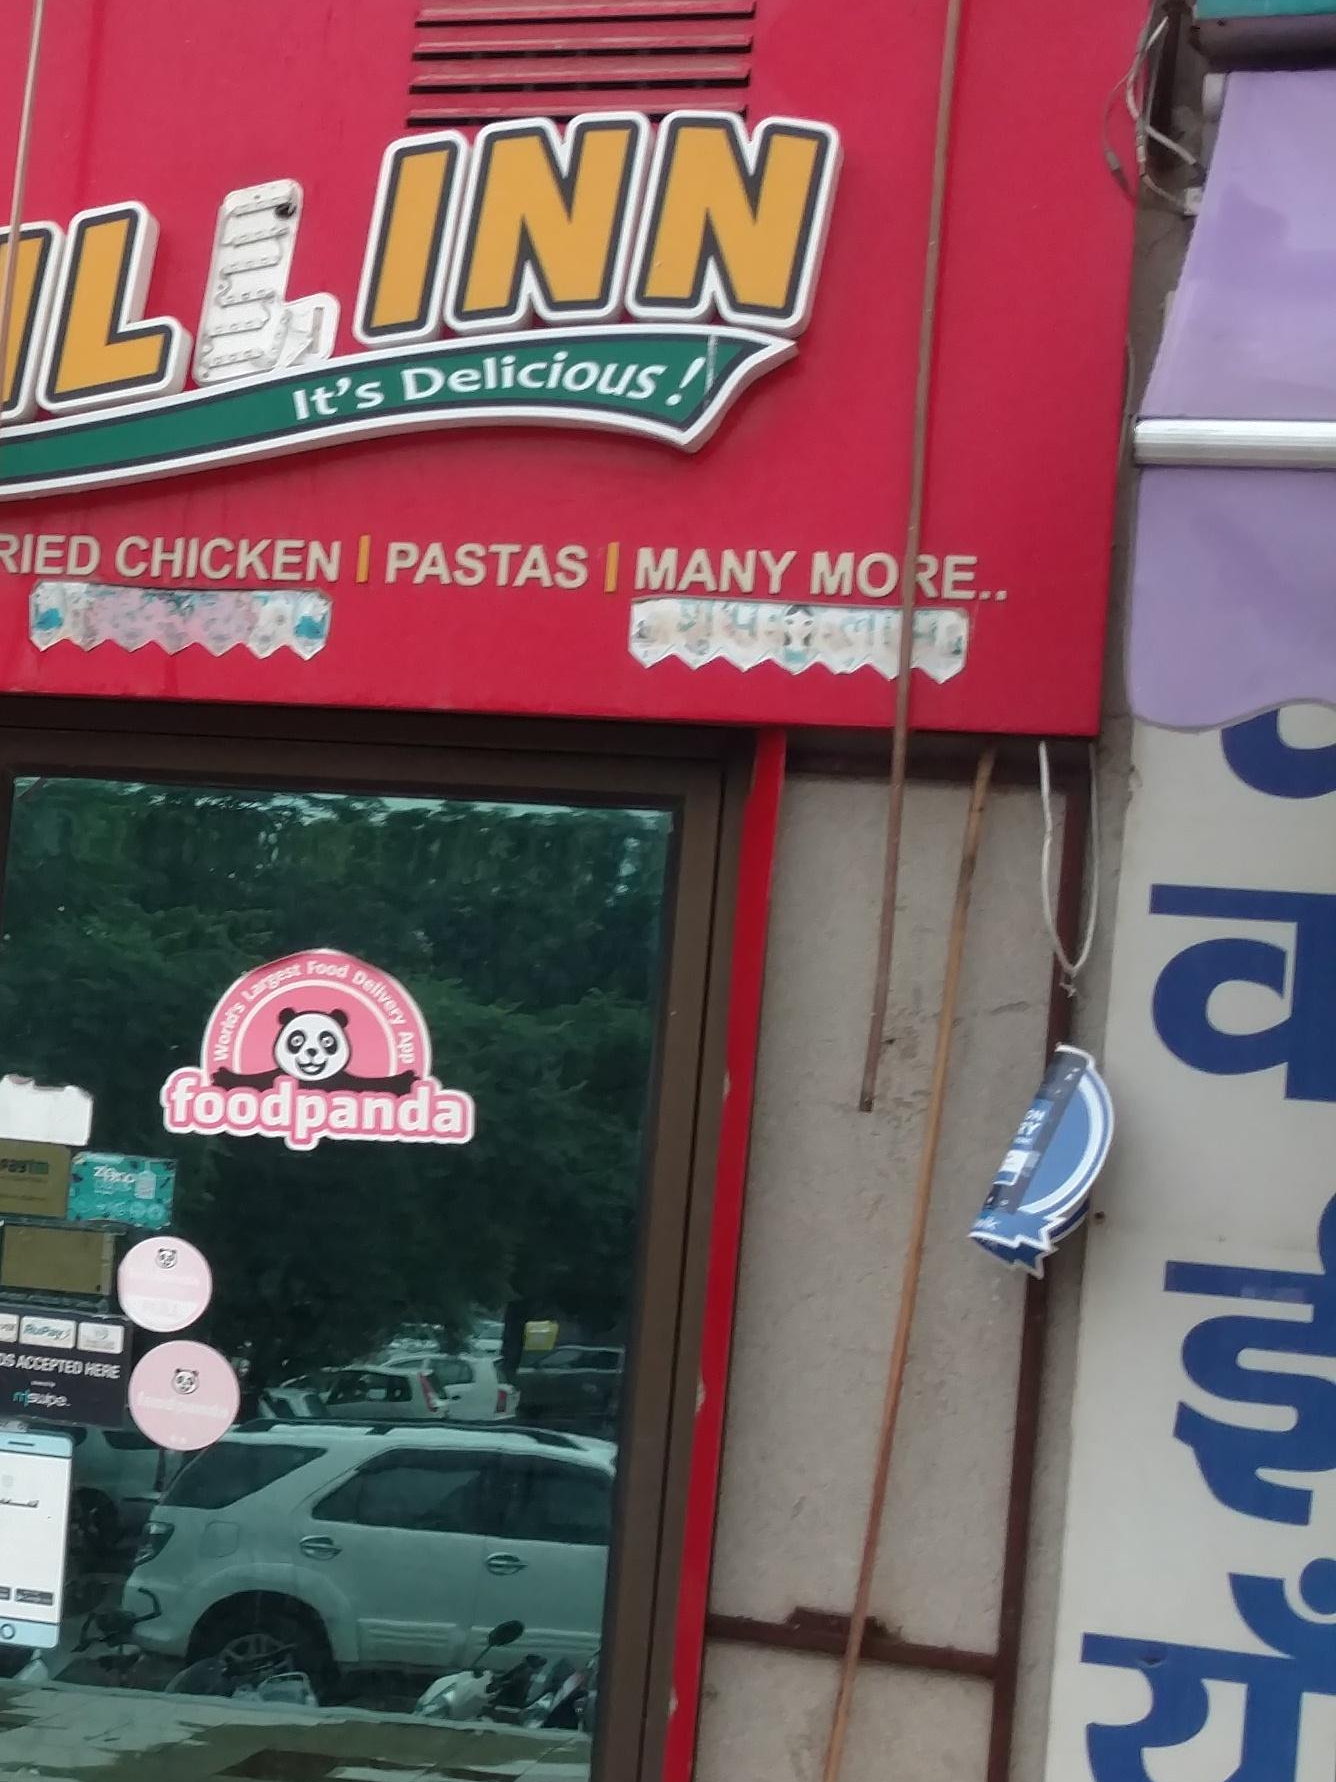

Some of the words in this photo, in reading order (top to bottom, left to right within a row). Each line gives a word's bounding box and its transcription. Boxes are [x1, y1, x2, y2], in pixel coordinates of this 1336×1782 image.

[355, 109, 843, 349] INN
[291, 367, 386, 423] It's
[113, 536, 342, 583] CHICKEN
[385, 541, 588, 590] PASTAS
[635, 547, 797, 595] MANY
[214, 1002, 246, 1063] World's
[241, 961, 302, 1002] Largest
[306, 959, 350, 979] Food
[351, 972, 407, 1026] Delivery
[397, 1030, 417, 1065] App
[172, 1077, 464, 1141] foodpanda
[16, 1354, 83, 1376] ACCEPTED
[84, 1358, 121, 1380] HERE
